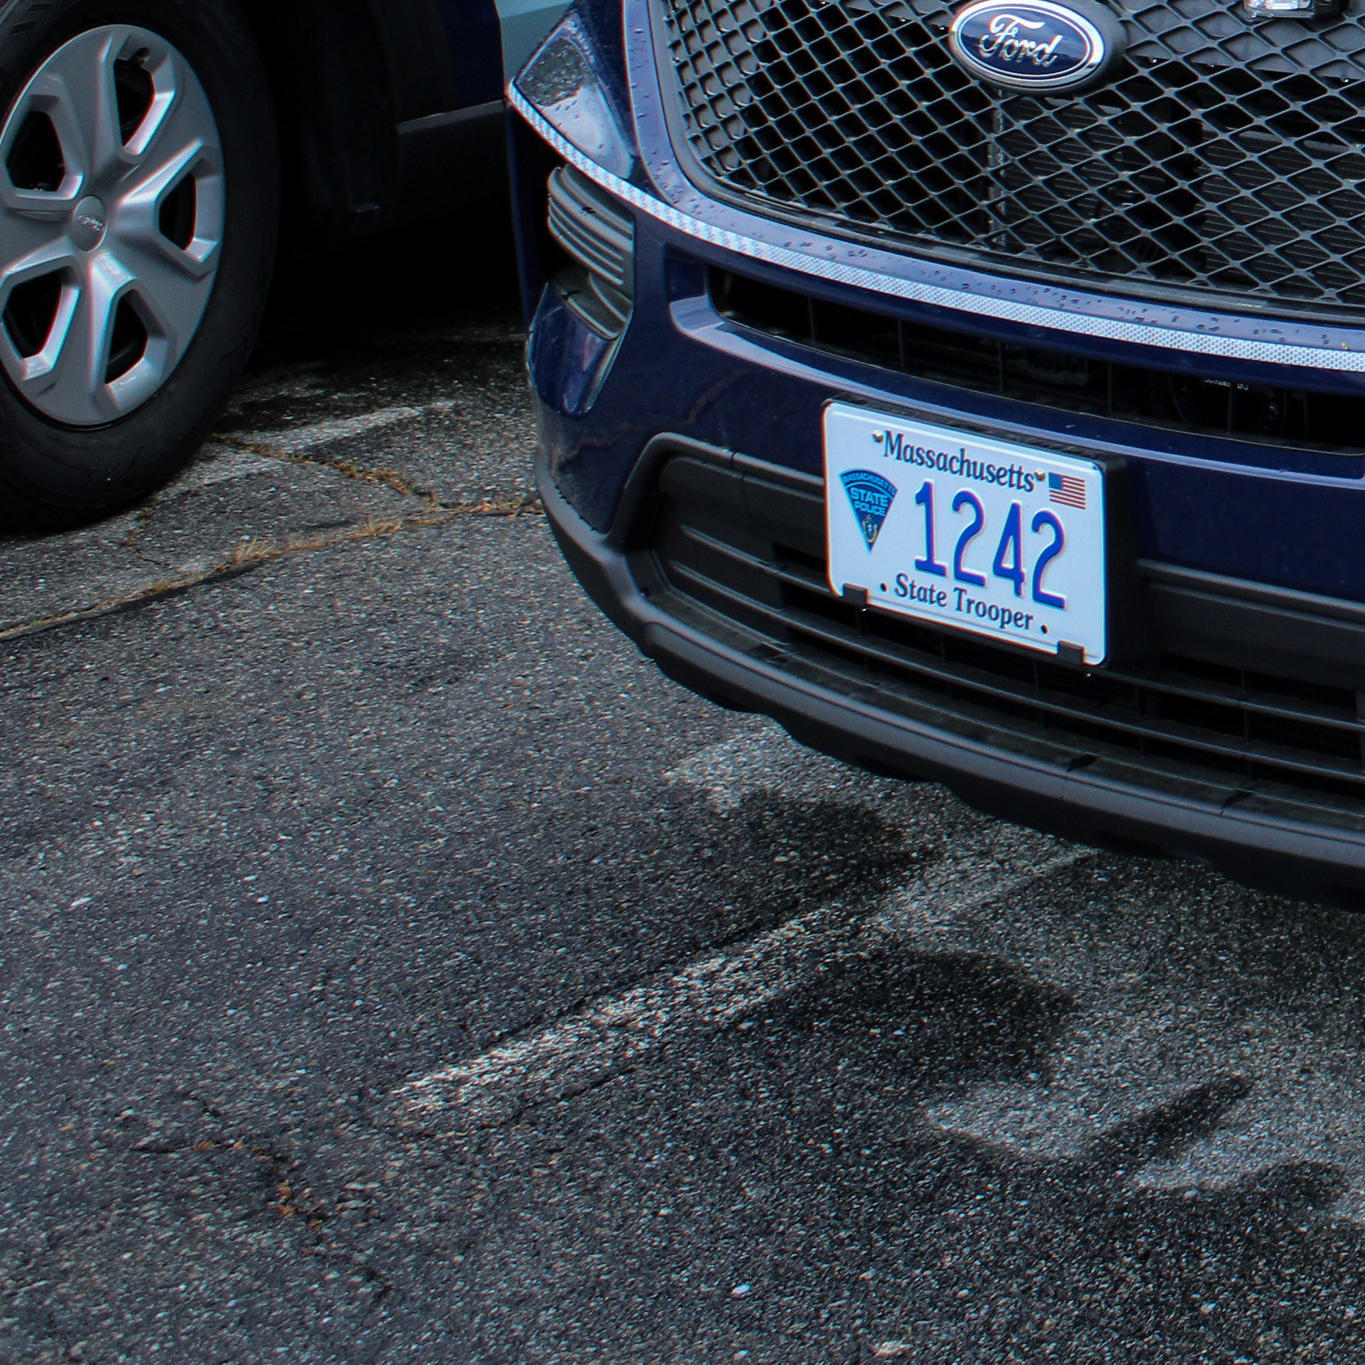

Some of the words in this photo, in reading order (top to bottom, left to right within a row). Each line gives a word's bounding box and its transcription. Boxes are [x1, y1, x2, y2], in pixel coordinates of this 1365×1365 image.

[979, 13, 1063, 68] Ford
[883, 429, 1035, 493] Massachusetts
[850, 486, 889, 508] STATE
[854, 500, 886, 517] POLICE
[914, 480, 1067, 610] 1242
[894, 572, 948, 608] State
[953, 587, 1034, 630] Trooper
